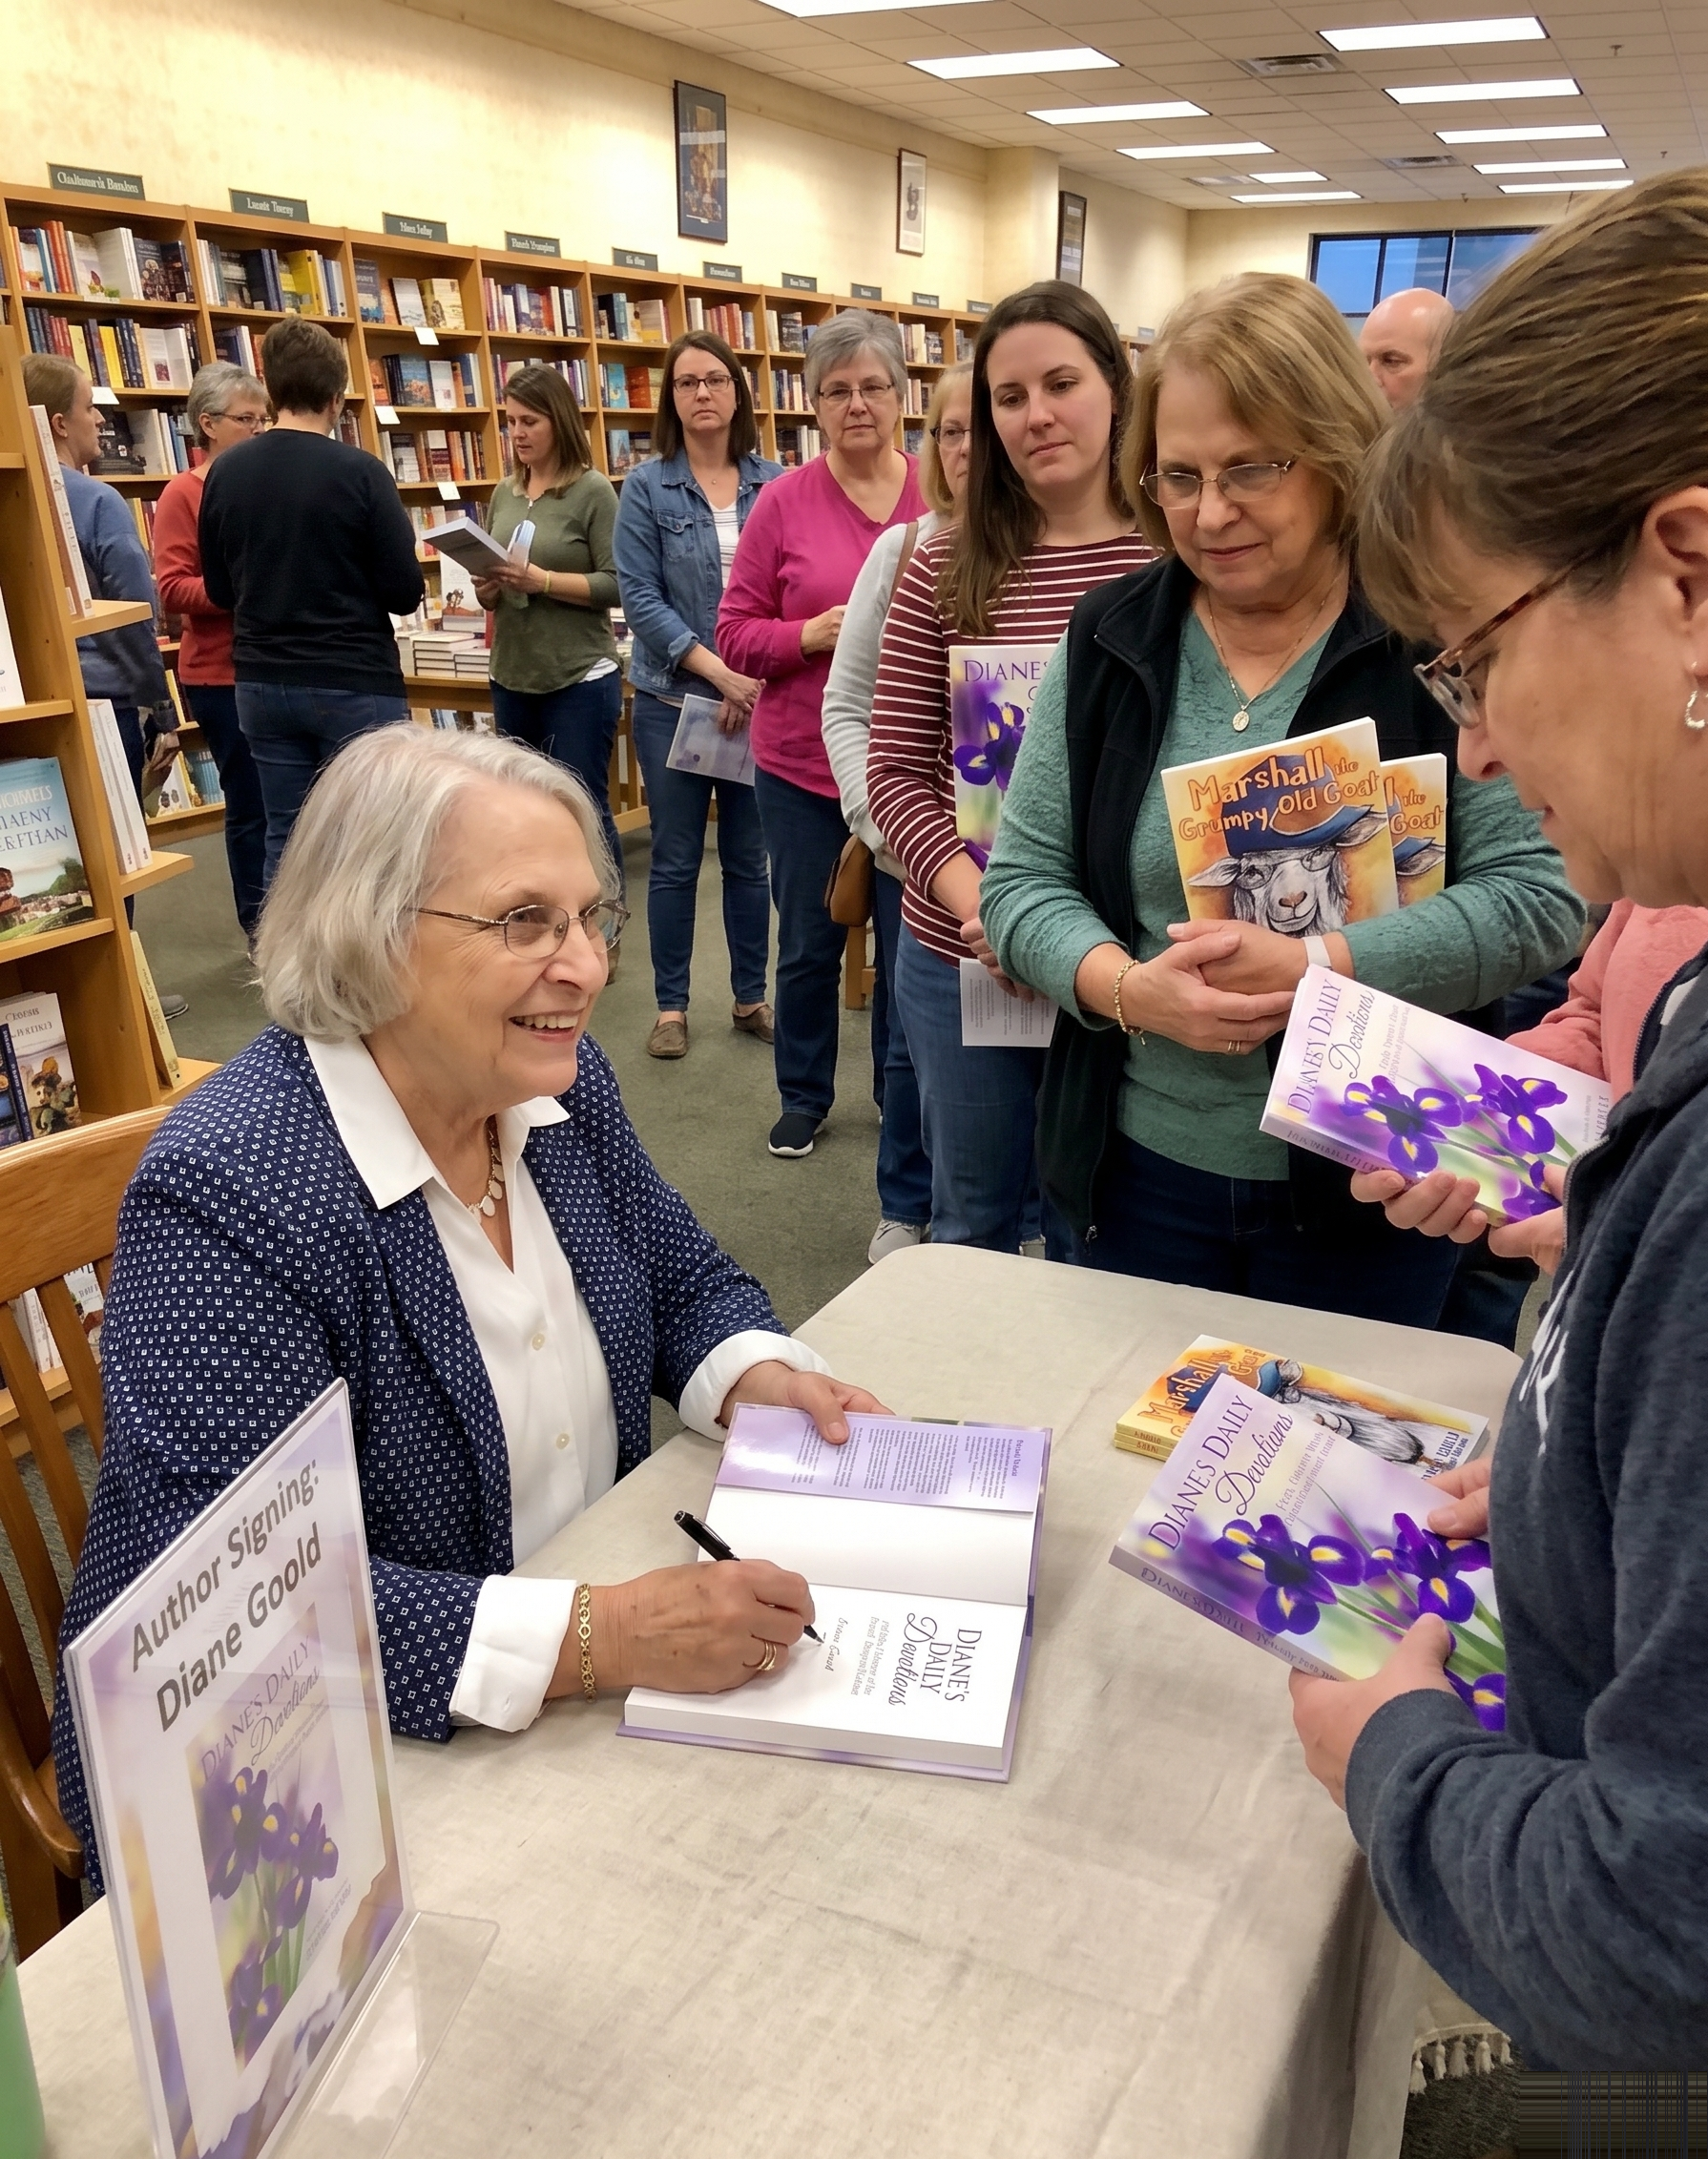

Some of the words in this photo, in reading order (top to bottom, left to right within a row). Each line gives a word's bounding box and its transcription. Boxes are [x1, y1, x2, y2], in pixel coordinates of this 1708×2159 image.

[963, 658, 1049, 682] DIANE
[1178, 806, 1268, 841] Grumpy
[1278, 789, 1318, 815] Old
[1323, 770, 1380, 804] Goat
[1188, 746, 1326, 811] Marshall
[1335, 757, 1359, 777] the
[1389, 804, 1444, 835] Goat
[1307, 979, 1342, 1037] DAILY
[1136, 1359, 1222, 1423] Marshall
[1201, 1394, 1254, 1460] DAILY
[1215, 1413, 1294, 1516] Devotions
[133, 1555, 221, 1672] Author
[227, 1459, 320, 1569] Signing:
[156, 1622, 242, 1732] Diane
[247, 1521, 322, 1628] Goold
[920, 1641, 952, 1694] DAILY
[944, 1629, 983, 1702] DIANE'S
[201, 1693, 263, 1782] DIANE'S
[265, 1634, 310, 1704] DAILY
